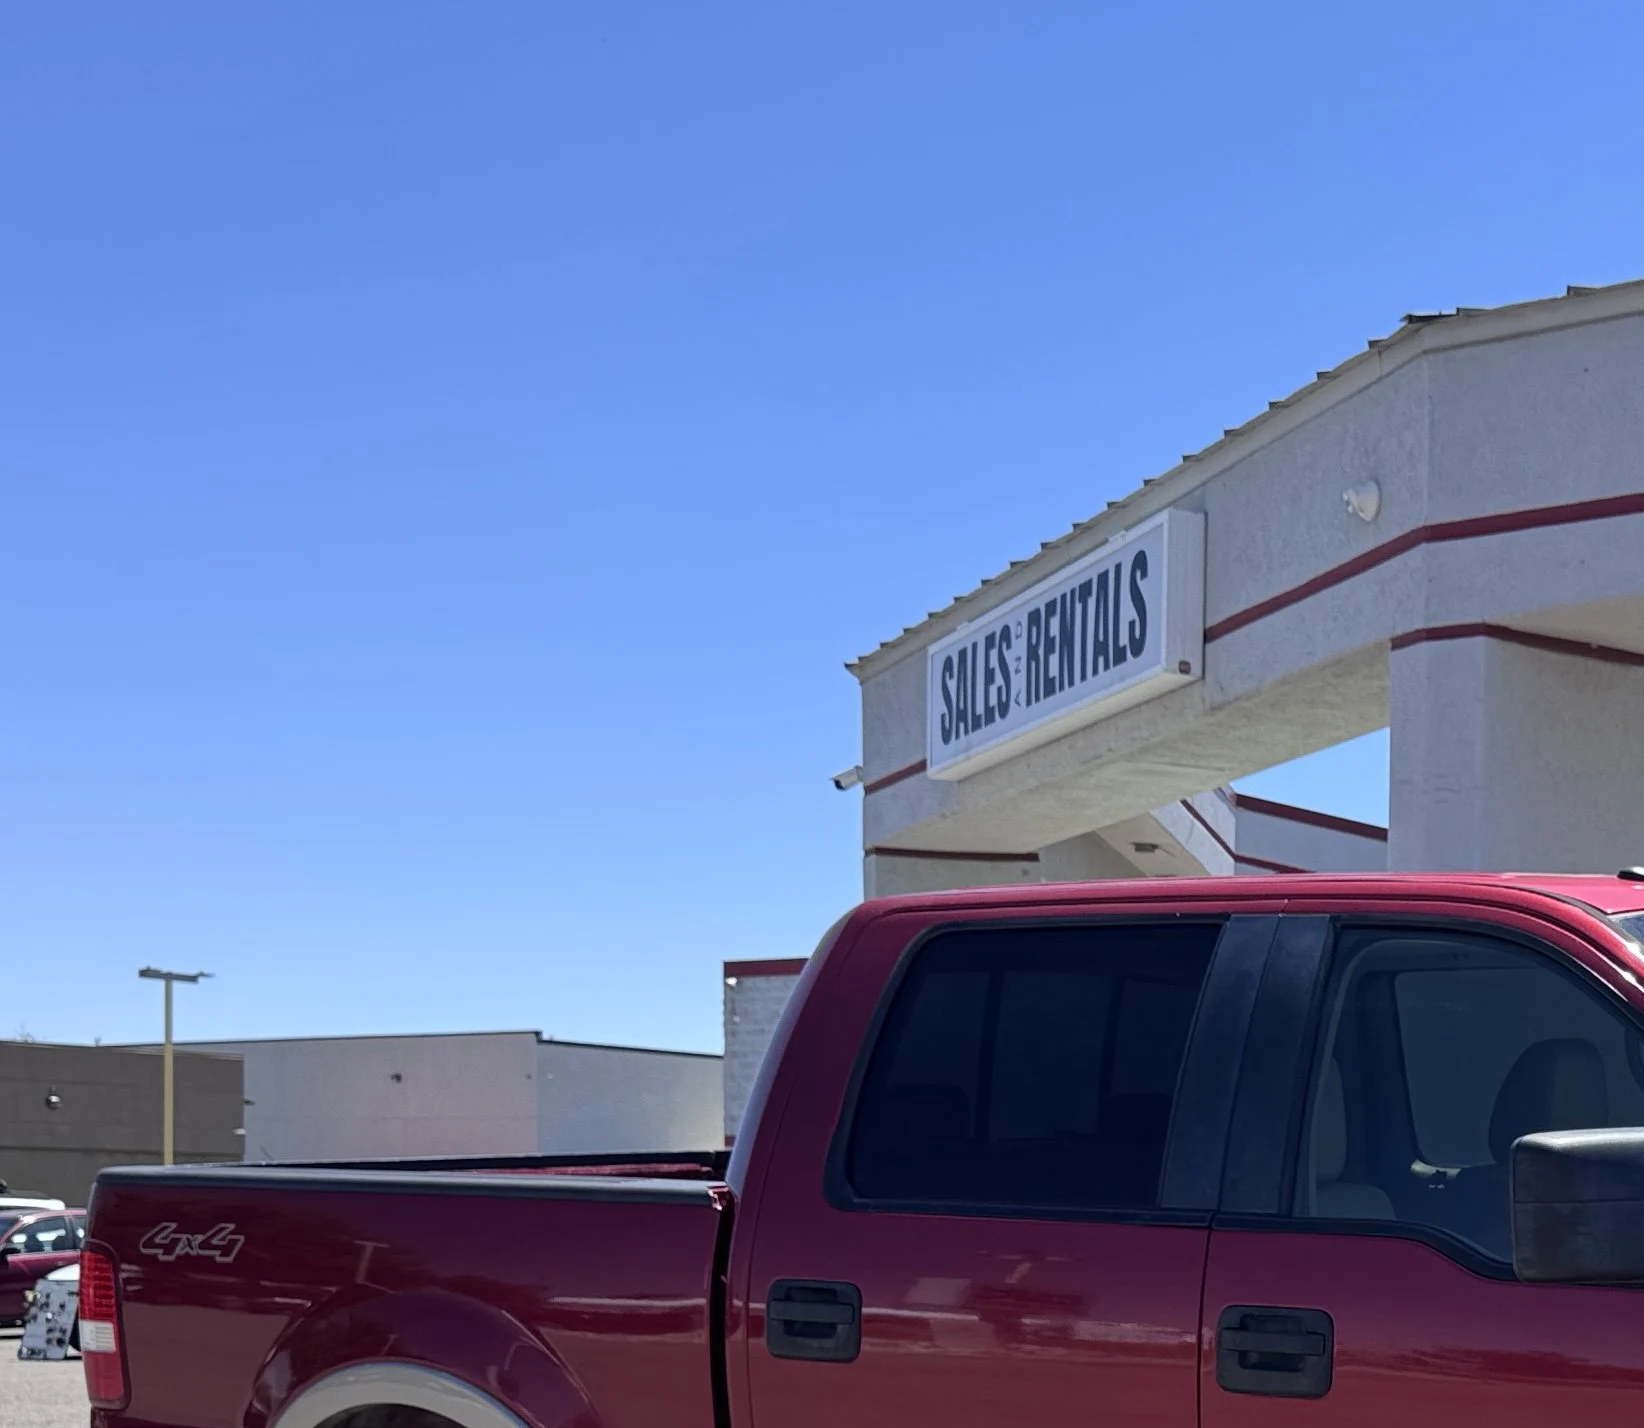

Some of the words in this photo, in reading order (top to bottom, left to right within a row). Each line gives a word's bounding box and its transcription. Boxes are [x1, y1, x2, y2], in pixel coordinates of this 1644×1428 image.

[940, 623, 1012, 746] SALES
[1025, 549, 1149, 709] RENTALS
[140, 1222, 244, 1263] 4x4
